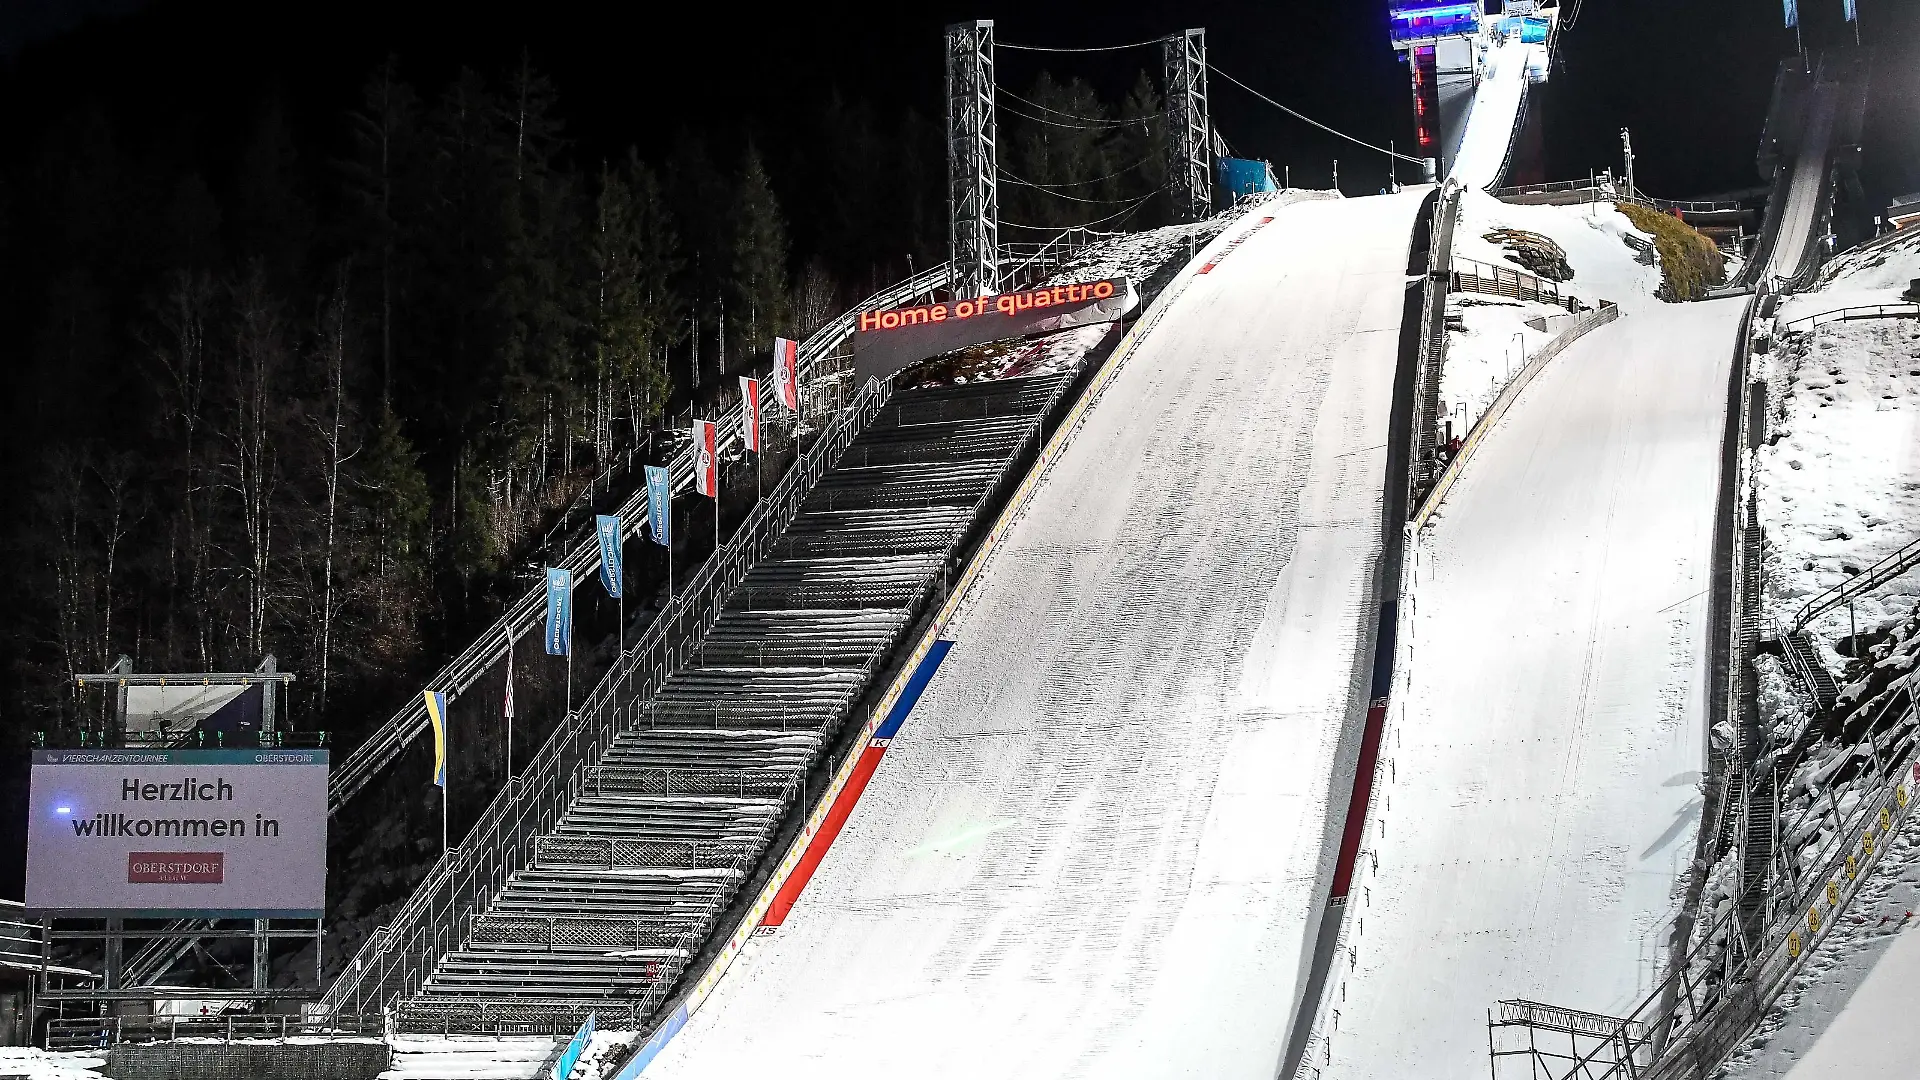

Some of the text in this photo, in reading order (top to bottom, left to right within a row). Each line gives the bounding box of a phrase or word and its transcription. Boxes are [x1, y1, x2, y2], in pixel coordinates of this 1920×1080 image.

[860, 280, 1114, 331] Home of quattro
[62, 754, 169, 763] VIERSCHANZENTOURNEE
[255, 754, 314, 763] OBERSTDORF
[122, 778, 233, 801] Herzlich
[72, 814, 279, 837] willkommen in
[132, 862, 219, 874] OBERSTDORF
[755, 927, 777, 935] HS
